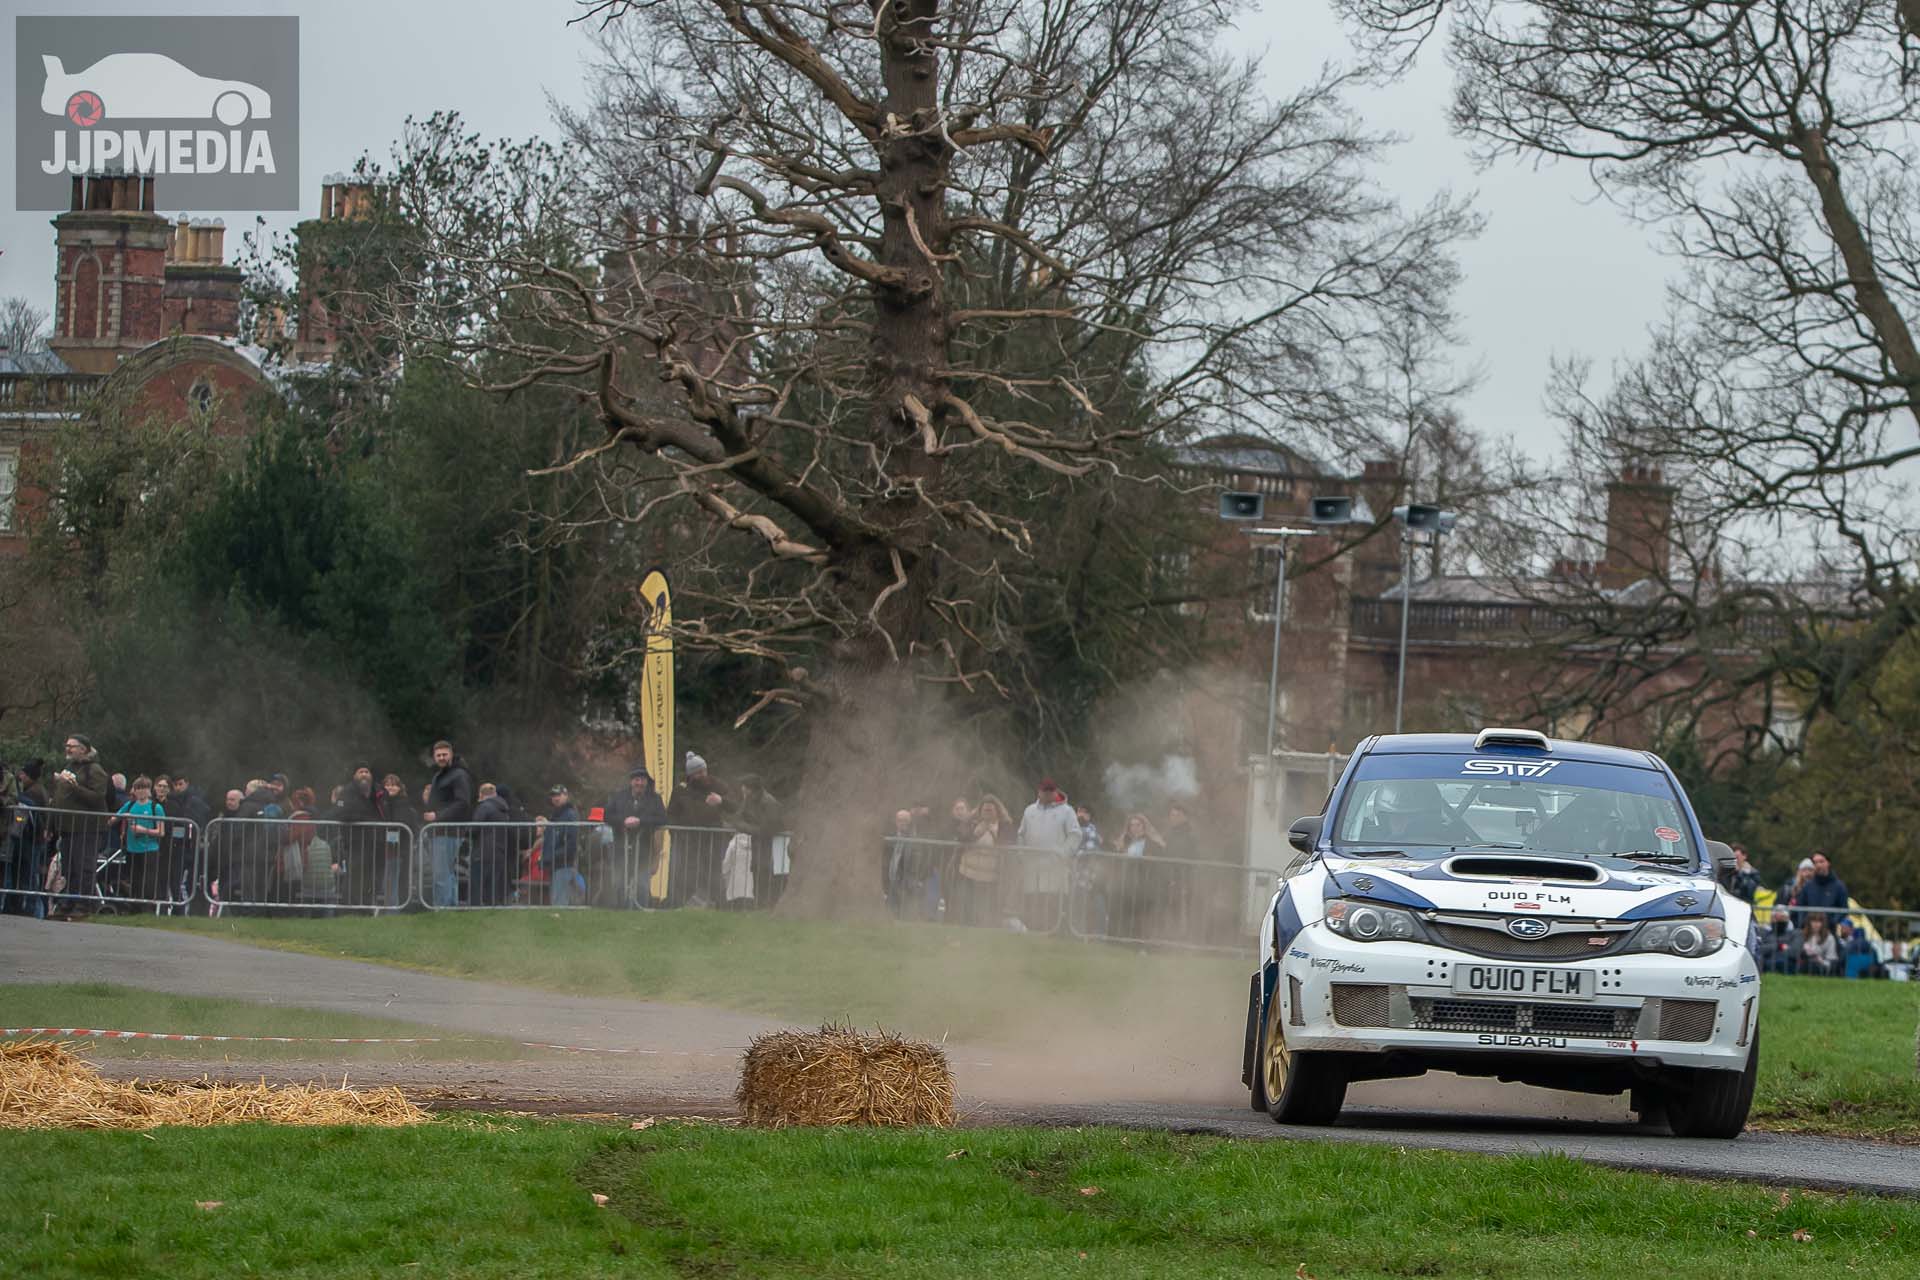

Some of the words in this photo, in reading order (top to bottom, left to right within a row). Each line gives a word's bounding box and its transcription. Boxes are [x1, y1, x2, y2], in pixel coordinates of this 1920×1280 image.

[1536, 893, 1571, 904] FLM
[1532, 970, 1581, 994] FLM
[1478, 1034, 1567, 1049] SUBARU
[1606, 1041, 1627, 1049] TOW
